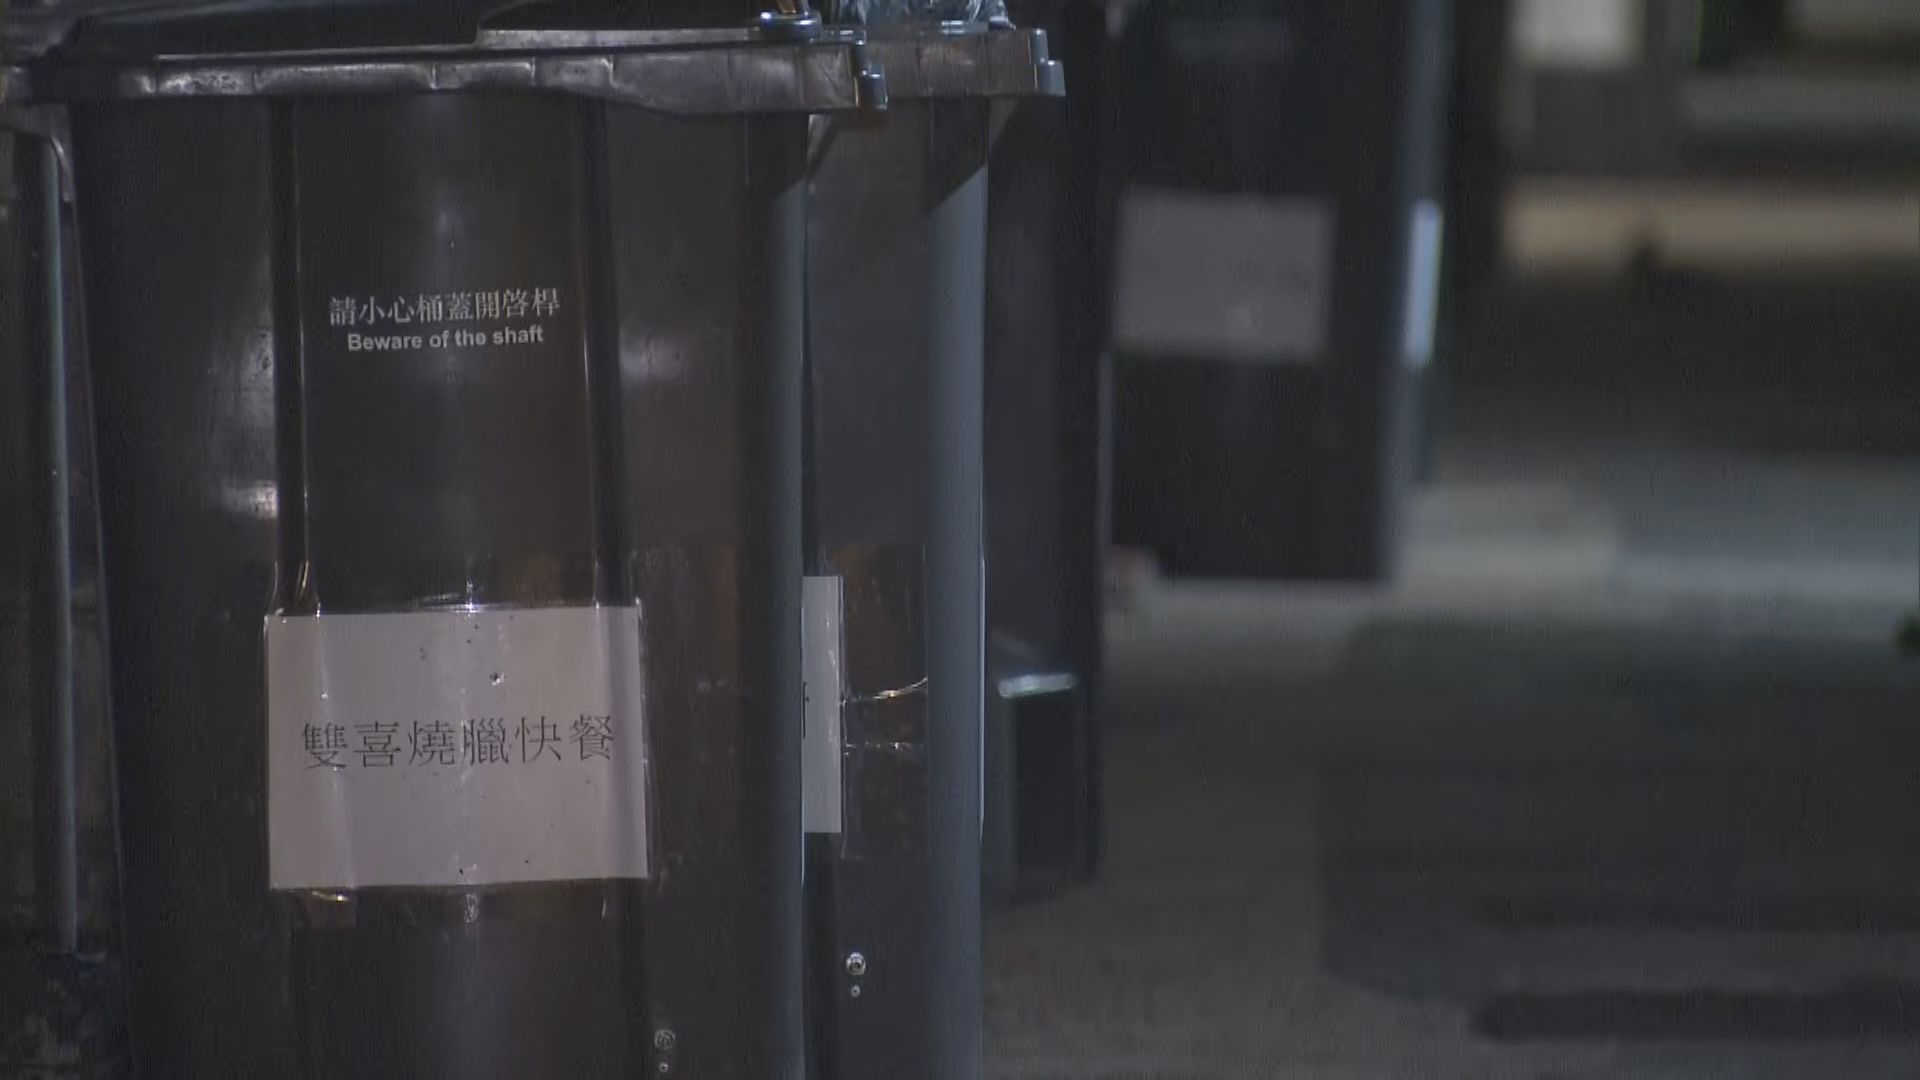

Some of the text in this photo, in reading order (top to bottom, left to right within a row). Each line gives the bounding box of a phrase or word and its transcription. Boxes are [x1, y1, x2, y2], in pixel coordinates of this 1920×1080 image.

[347, 324, 544, 351] Beware of the shaft
